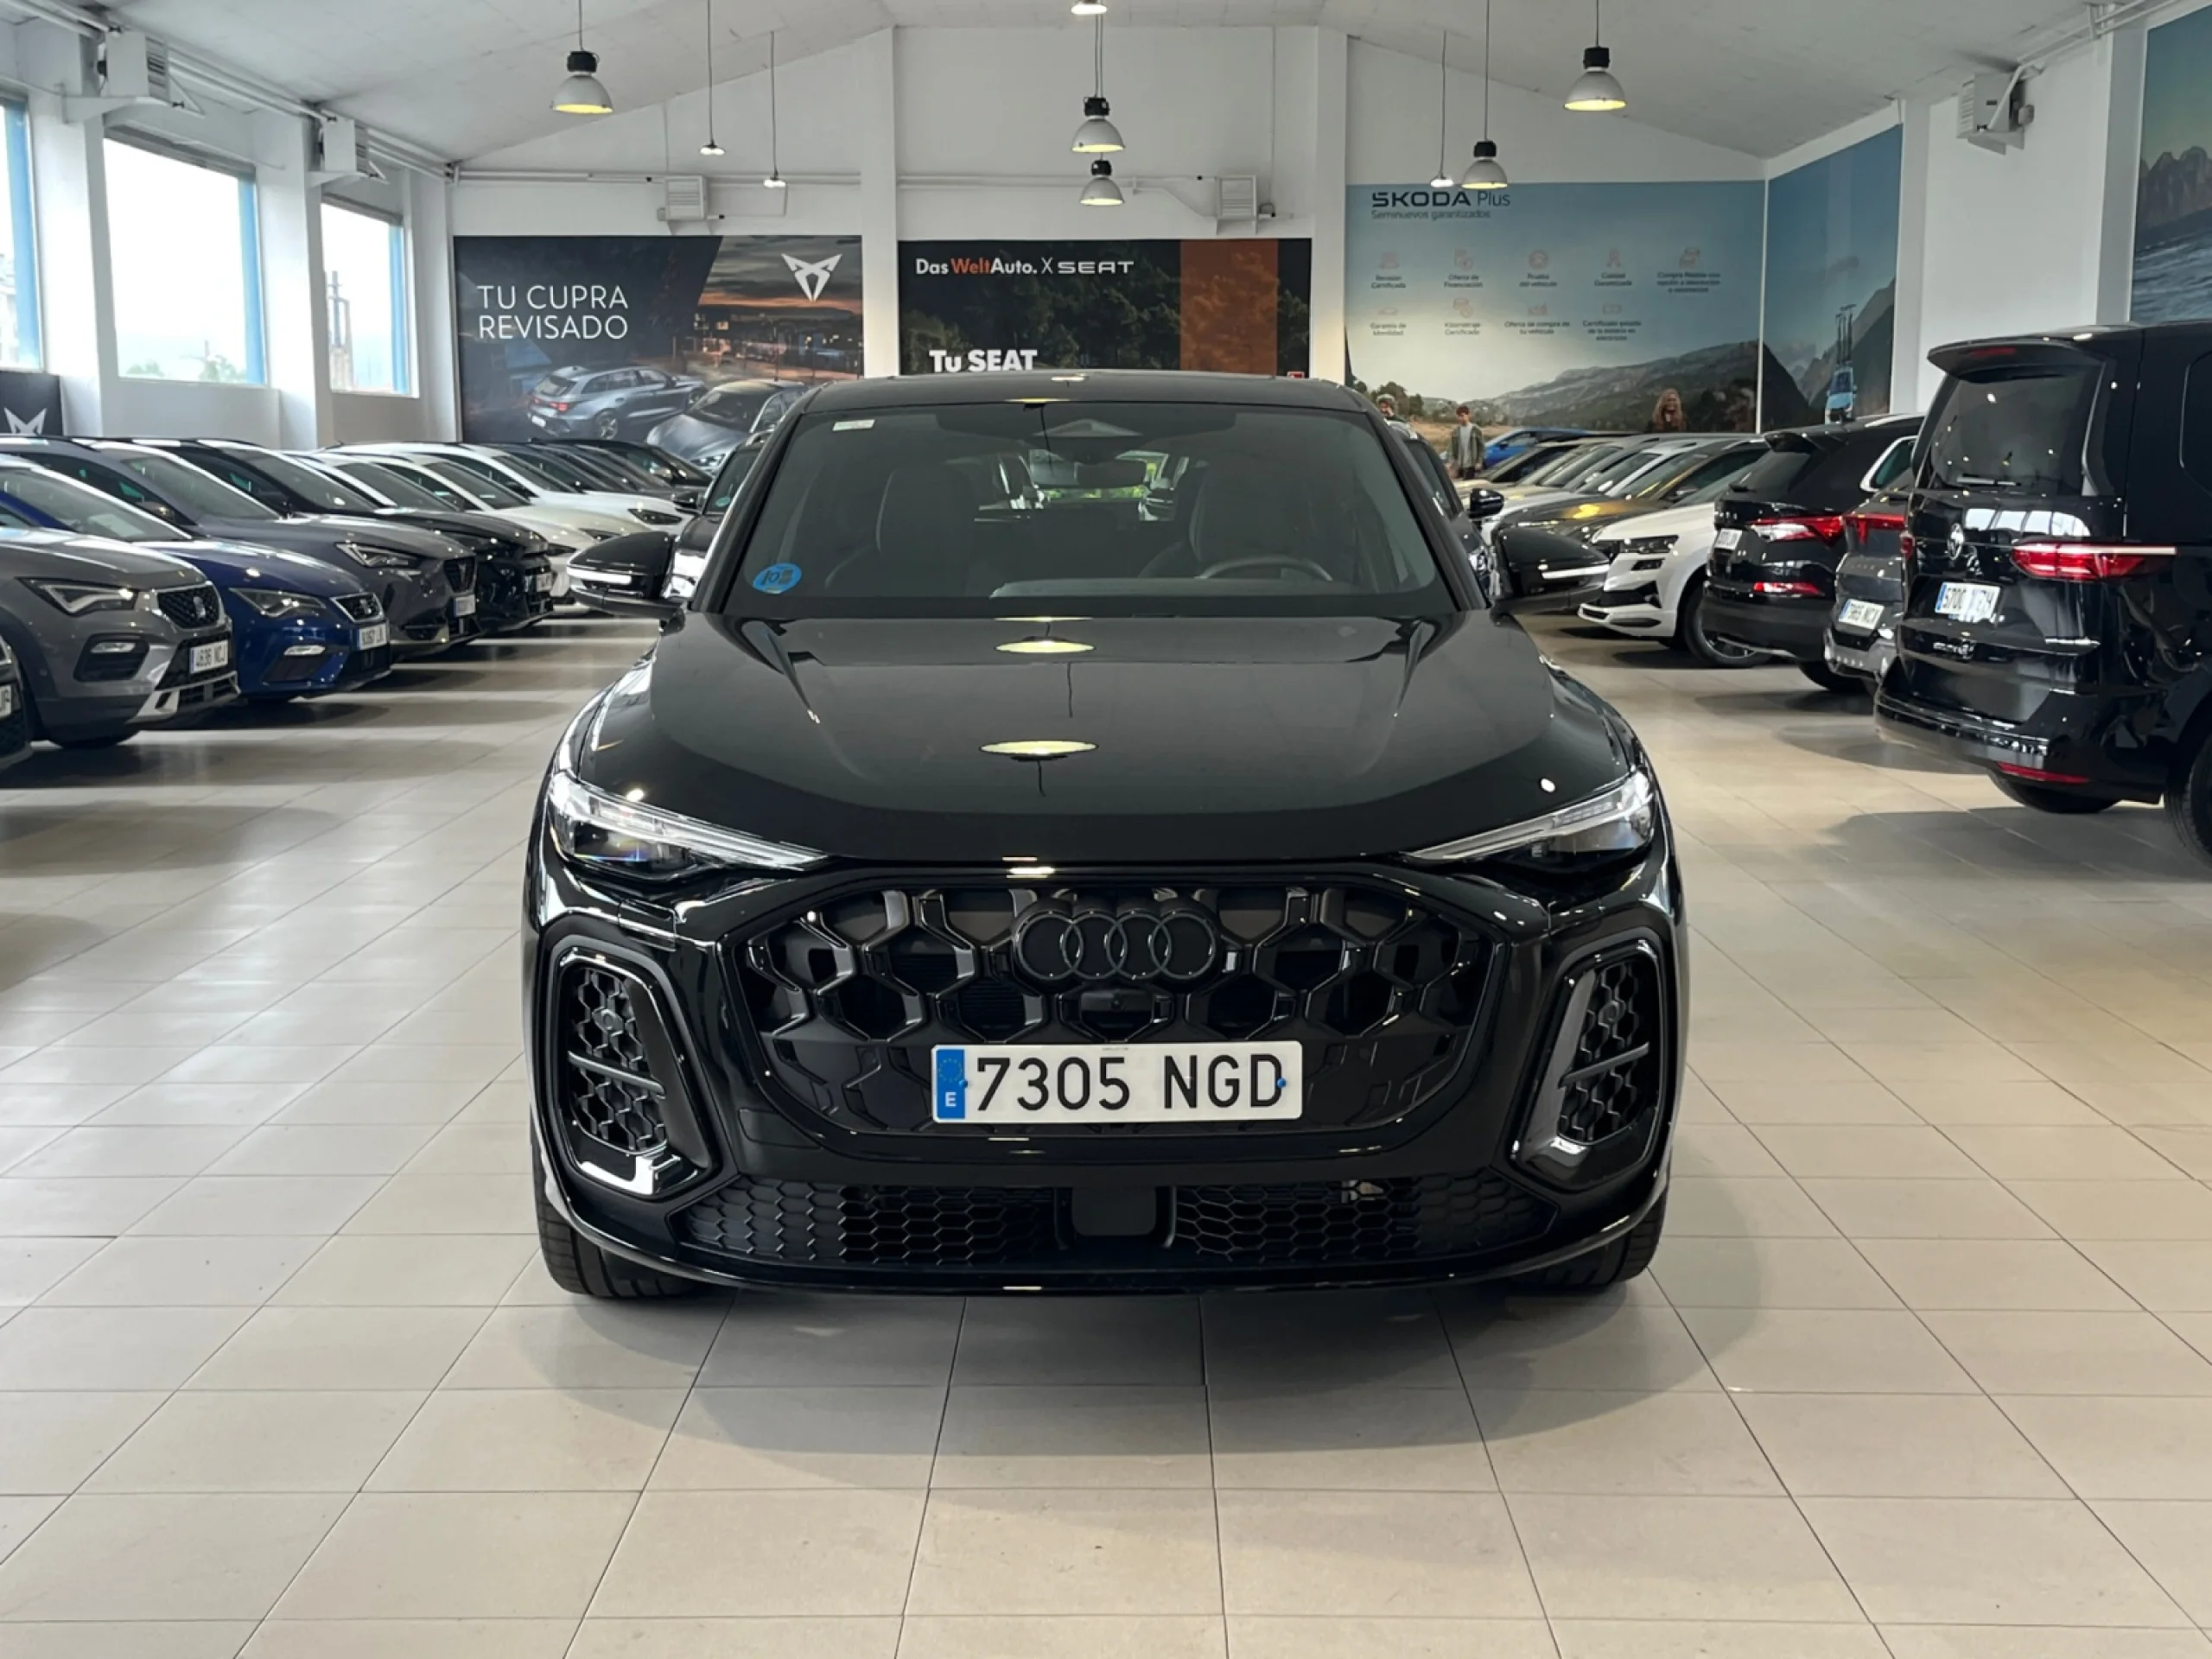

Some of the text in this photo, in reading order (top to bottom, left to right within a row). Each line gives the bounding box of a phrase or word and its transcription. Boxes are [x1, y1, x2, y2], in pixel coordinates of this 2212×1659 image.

[1477, 190, 1511, 207] Plus
[1370, 209, 1491, 221] Seminuevos garantizados
[916, 257, 949, 275] Das
[950, 257, 1038, 275] WeltAuto.
[1057, 261, 1135, 275] SEAT
[477, 285, 628, 309] TU CUPRA
[479, 315, 628, 340] REVISADO
[928, 349, 1039, 372] Tu SEAT
[976, 1054, 1283, 1111] 7305 NGD
[944, 1091, 957, 1107] E
